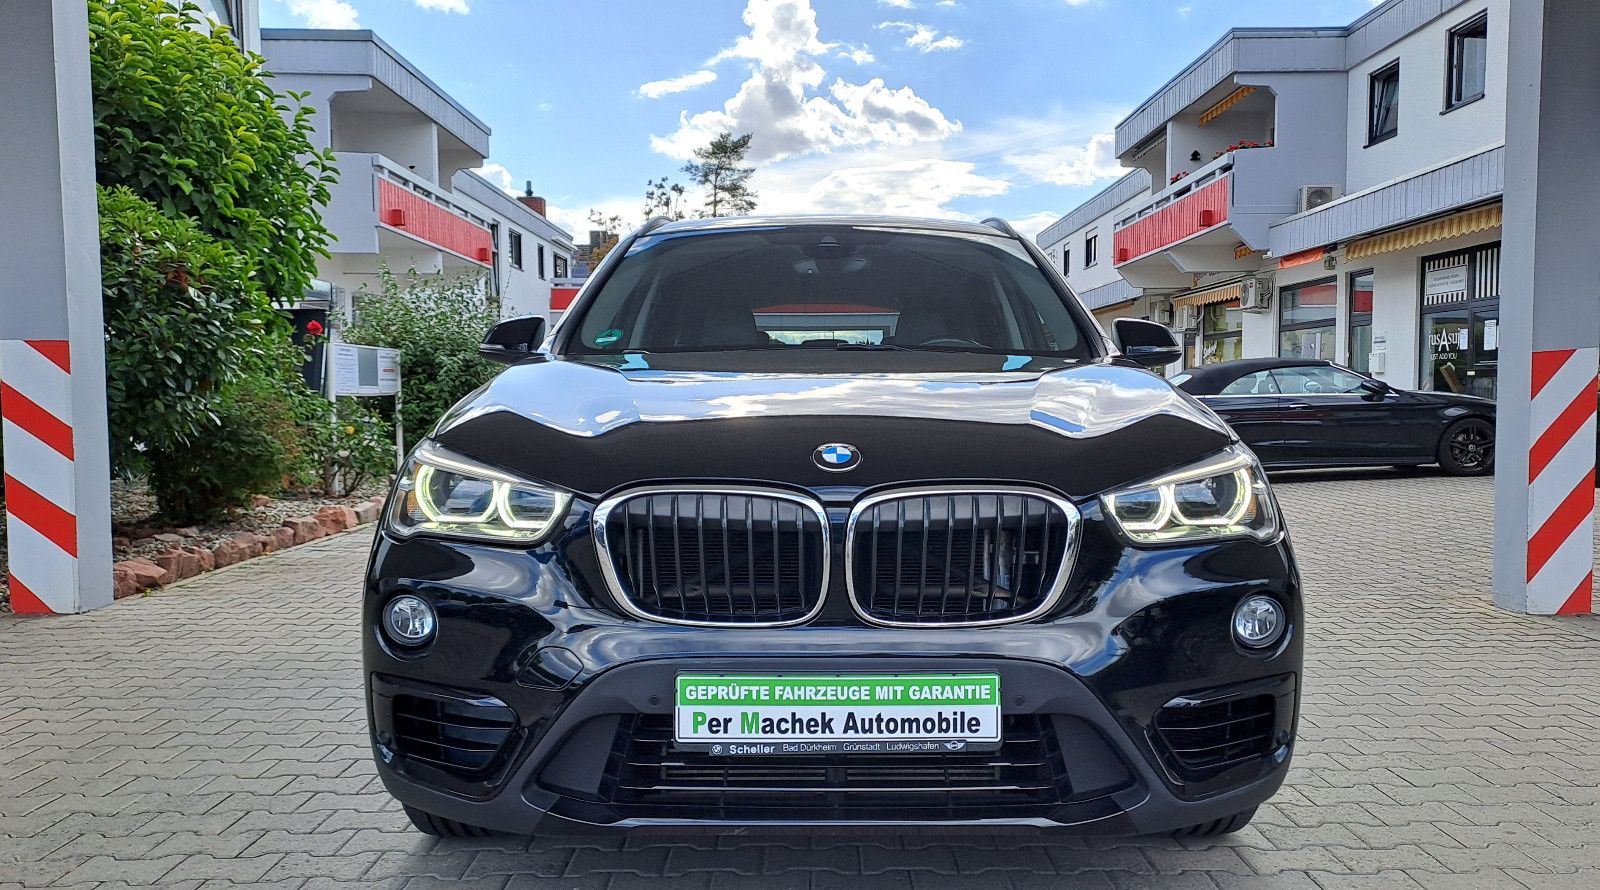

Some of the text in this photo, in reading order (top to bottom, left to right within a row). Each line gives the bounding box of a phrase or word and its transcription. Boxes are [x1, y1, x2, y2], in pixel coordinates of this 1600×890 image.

[1448, 352, 1458, 360] YOU
[685, 683, 991, 700] GEPRÜFTE FAHRZEUGE MIT GARANTIE
[692, 711, 981, 735] Per Machek Automobile
[729, 744, 775, 754] Scheller
[782, 743, 798, 752] Bad
[800, 743, 837, 752] Dürkheim
[843, 742, 880, 751] Grünstadt
[886, 742, 940, 751] Ludwigshafen
